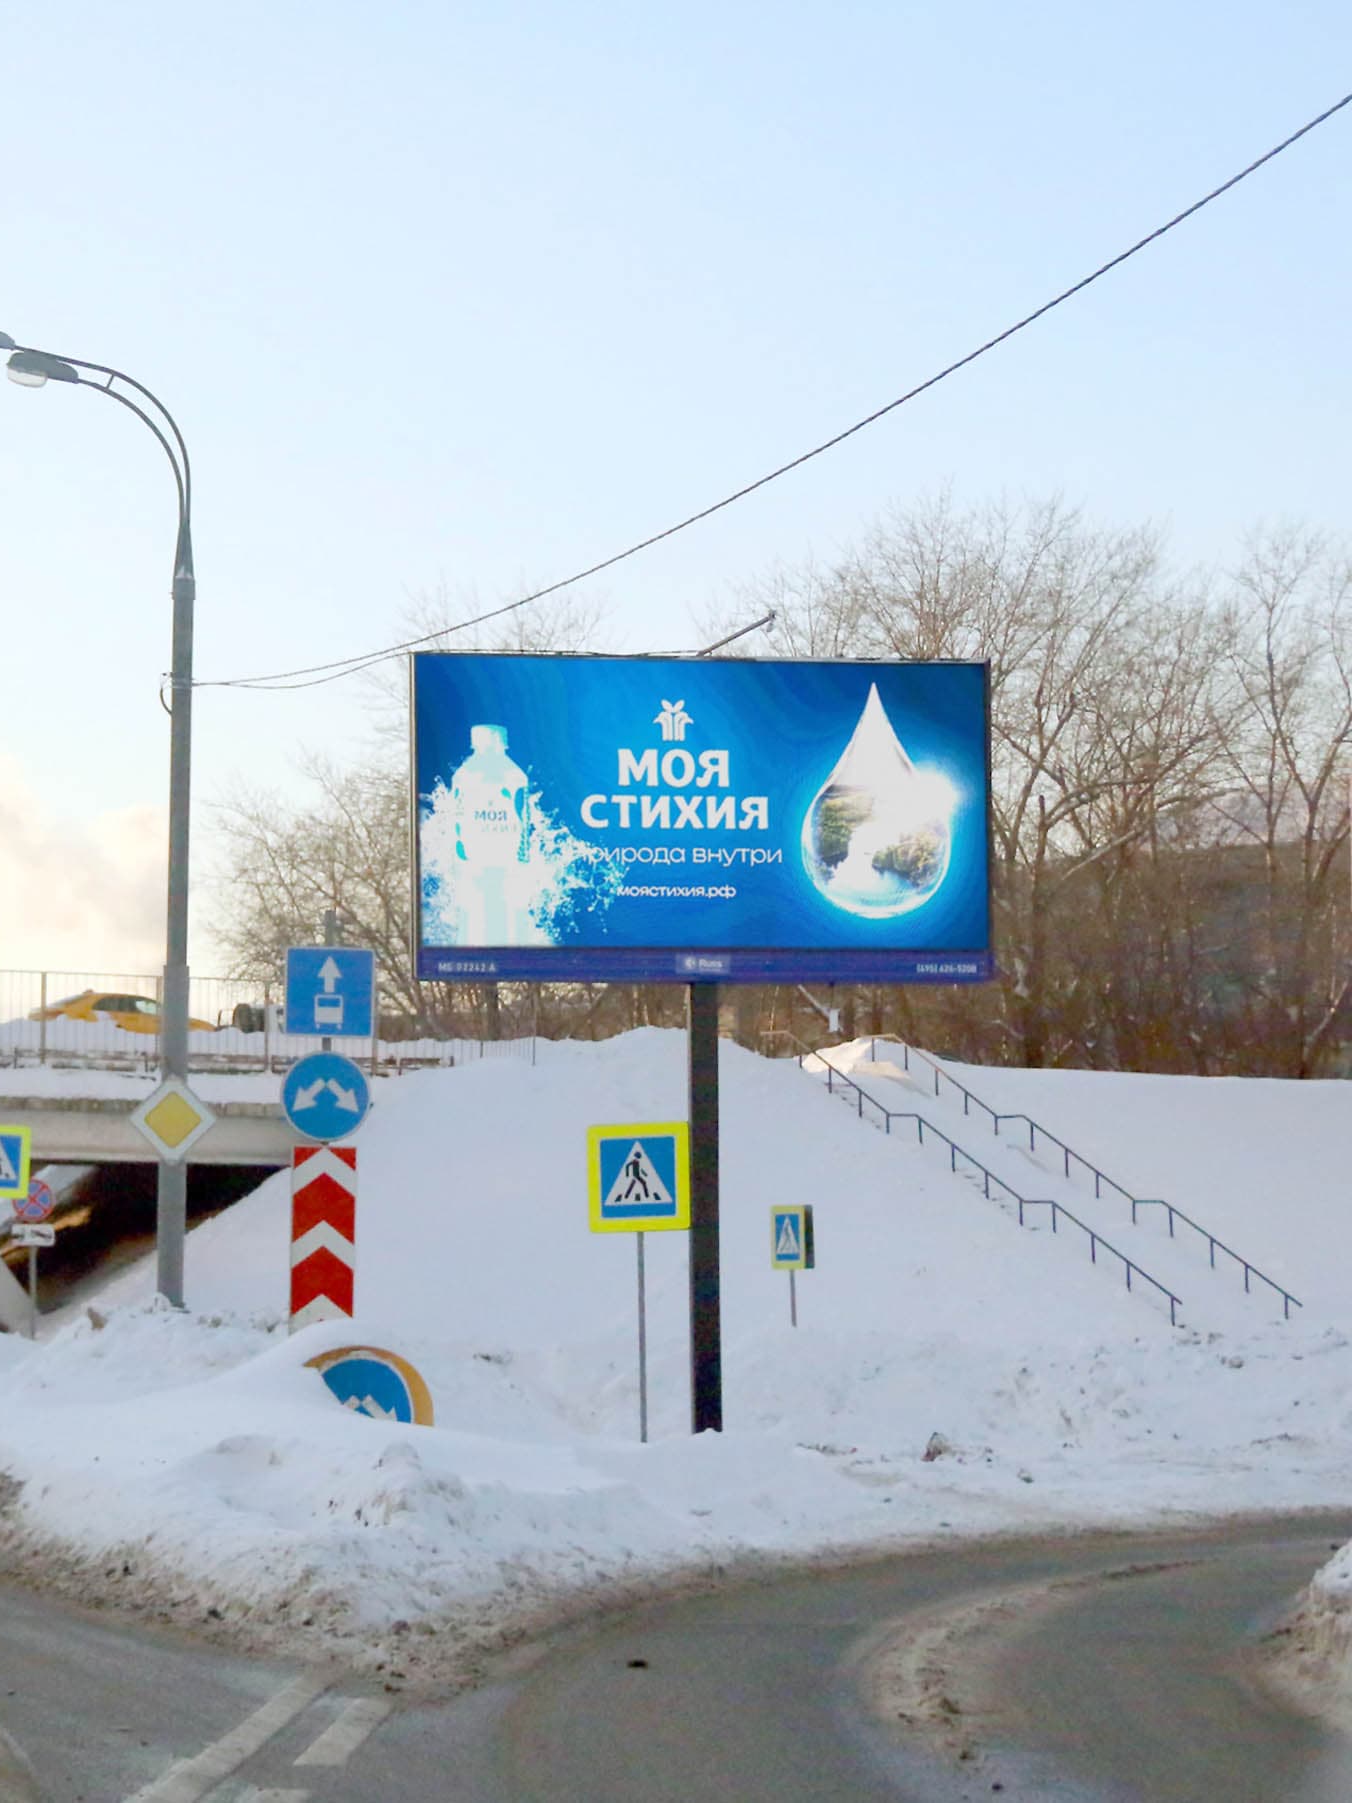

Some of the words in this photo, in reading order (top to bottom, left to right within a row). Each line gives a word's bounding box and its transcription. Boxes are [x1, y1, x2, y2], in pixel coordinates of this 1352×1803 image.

[617, 748, 730, 788] МОЯ
[580, 793, 769, 831] СТИХИЯ
[573, 847, 686, 867] рирода
[692, 847, 784, 868] внутри
[616, 885, 737, 899] моястихия.рф
